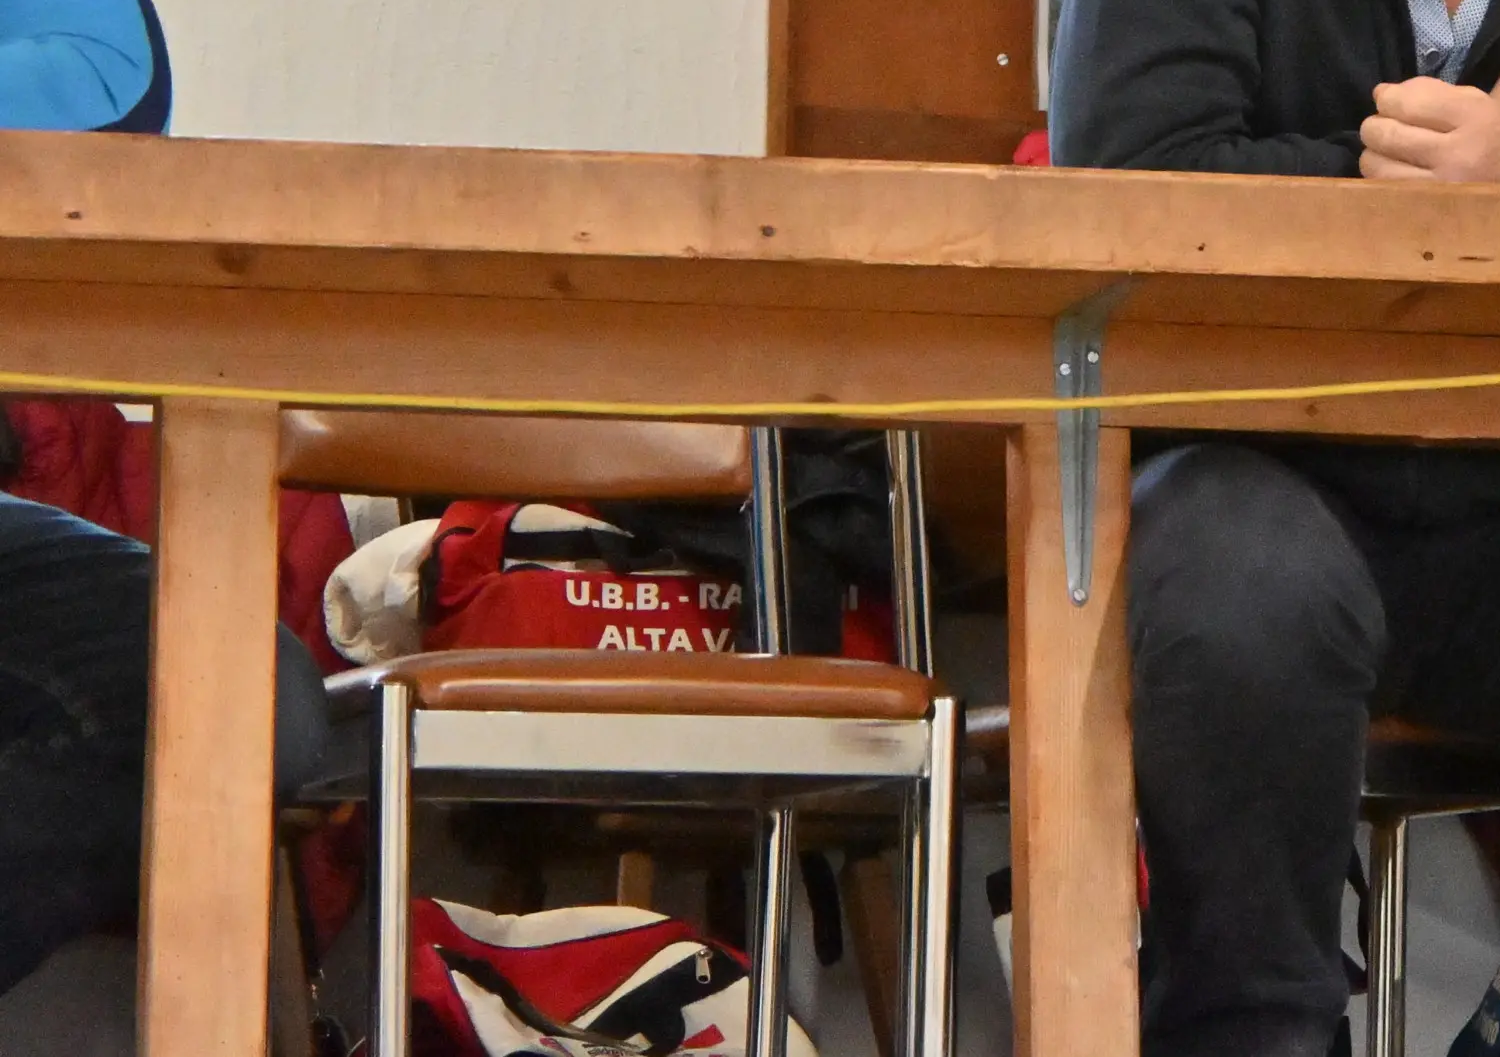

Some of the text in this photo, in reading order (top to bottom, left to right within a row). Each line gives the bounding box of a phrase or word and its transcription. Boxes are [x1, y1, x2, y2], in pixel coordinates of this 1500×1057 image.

[565, 579, 670, 611] U.B.B.
[596, 625, 736, 653] ALTA V
